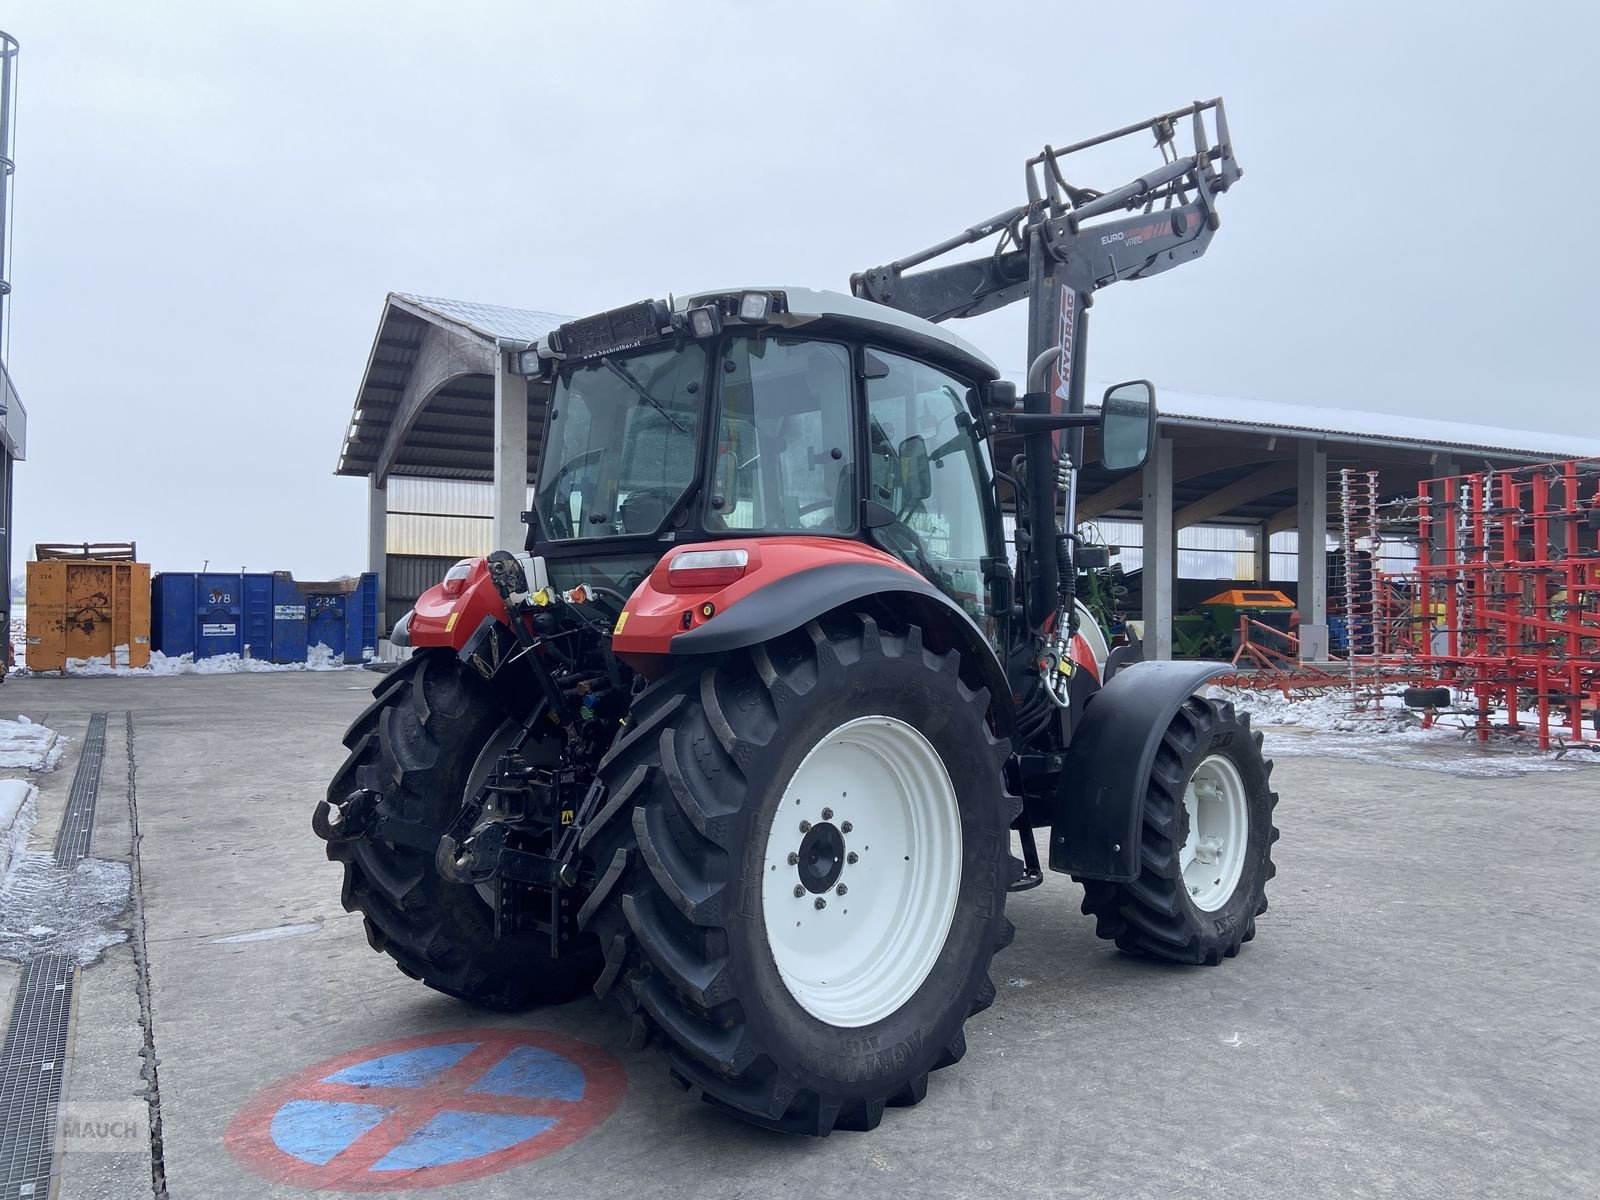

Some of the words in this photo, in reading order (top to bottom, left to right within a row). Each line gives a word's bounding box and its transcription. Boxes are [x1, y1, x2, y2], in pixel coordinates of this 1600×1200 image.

[1101, 232, 1124, 245] EURO
[1062, 293, 1074, 382] HYDRAC
[208, 593, 231, 604] 378
